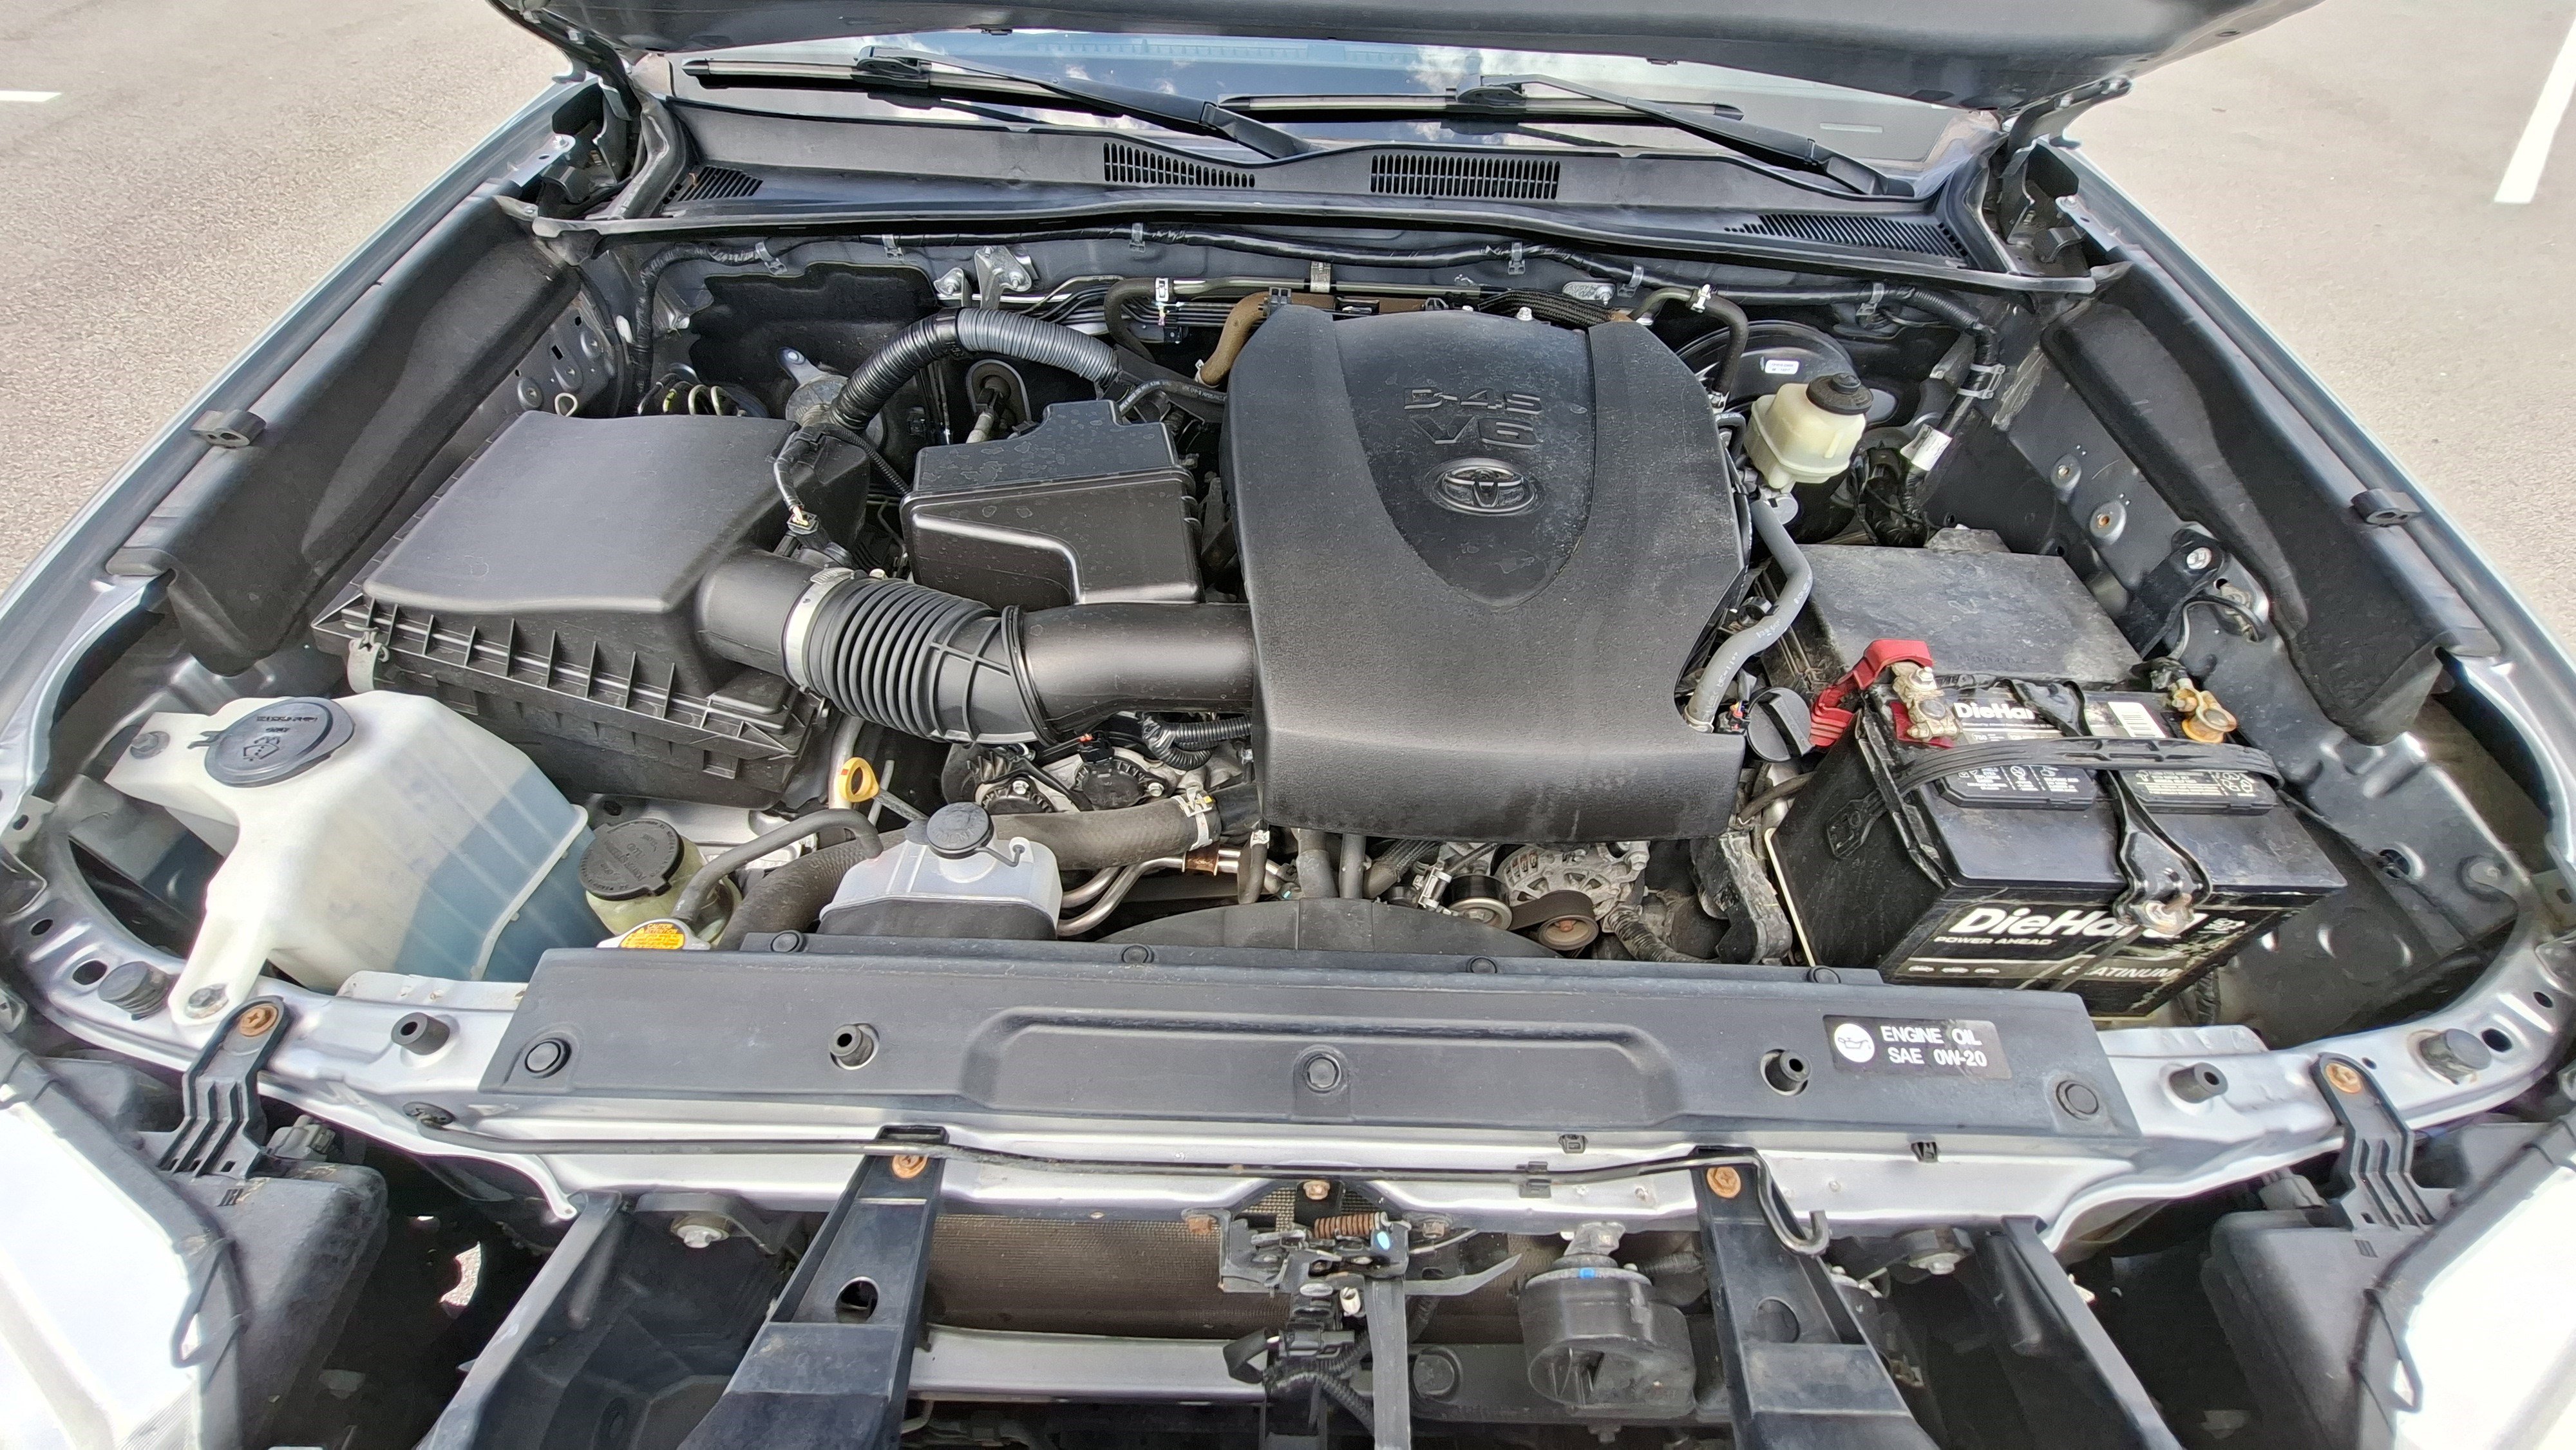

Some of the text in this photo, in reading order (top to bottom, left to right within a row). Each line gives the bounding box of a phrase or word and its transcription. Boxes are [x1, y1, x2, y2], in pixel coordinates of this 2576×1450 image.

[1404, 388, 1542, 415] D-4S
[1410, 416, 1543, 449] V6
[1953, 702, 2035, 720] DieHar
[1933, 936, 1994, 945] POWER
[2061, 966, 2184, 977] PATINUM
[1880, 1025, 1983, 1046] ENGINE OIL
[1888, 1047, 1987, 1067] SAE 0W-20
